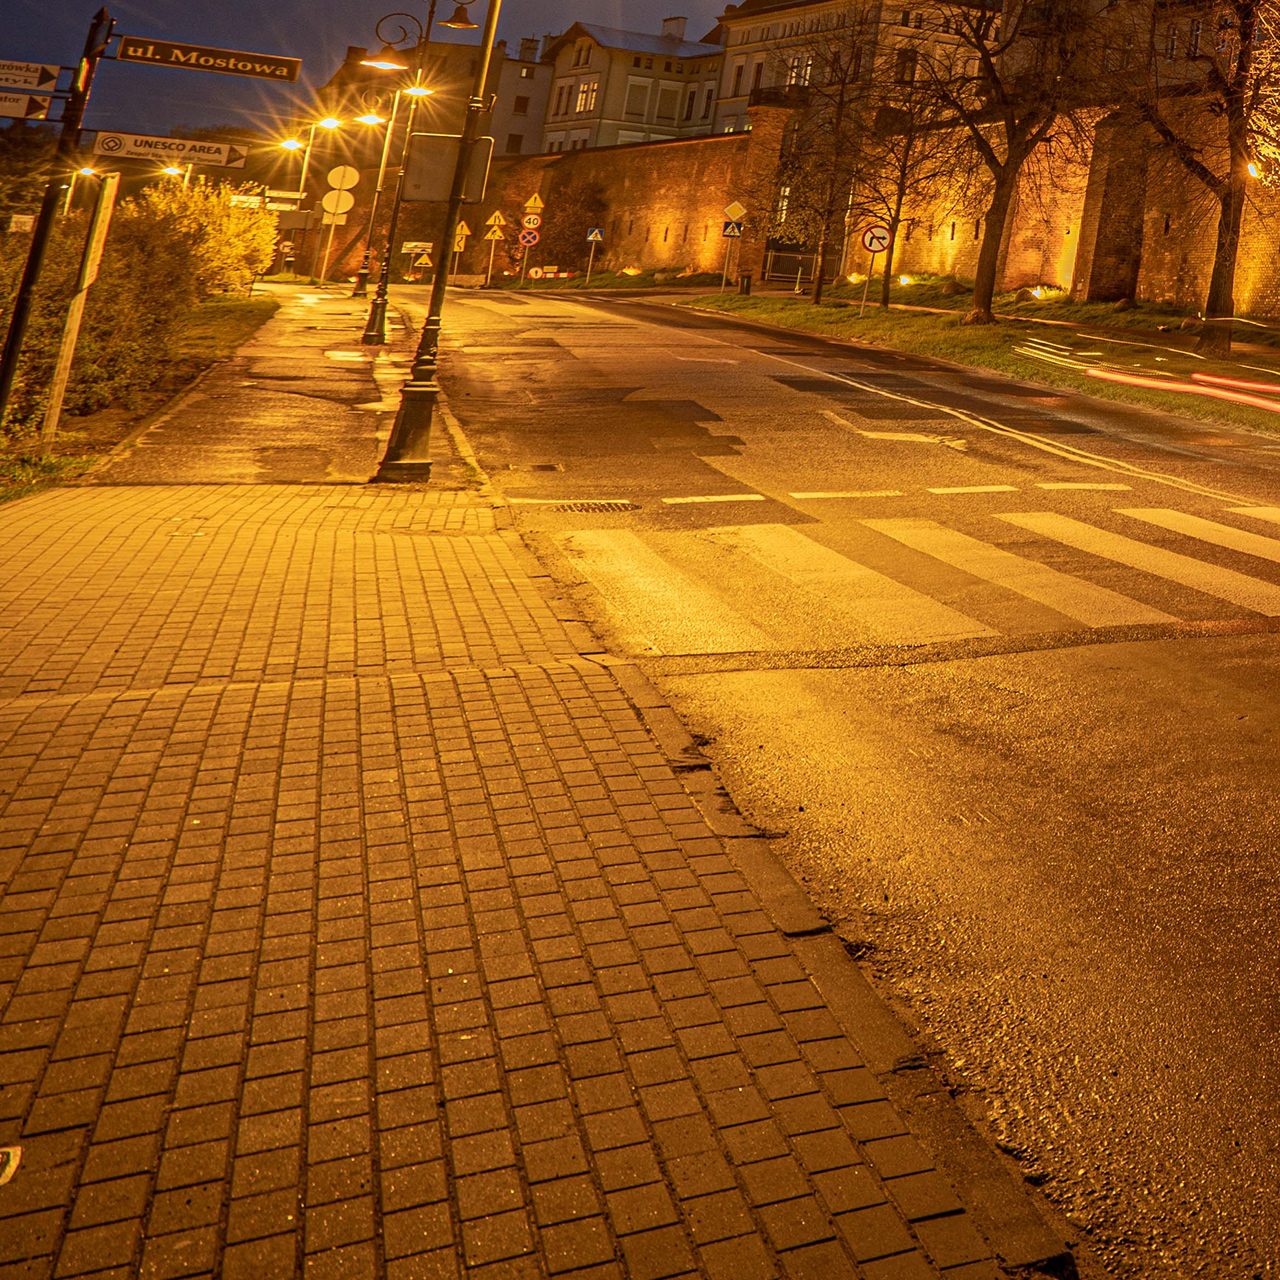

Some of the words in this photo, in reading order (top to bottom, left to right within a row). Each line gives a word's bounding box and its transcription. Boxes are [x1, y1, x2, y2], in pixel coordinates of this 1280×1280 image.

[127, 45, 161, 59] ul.
[168, 48, 289, 77] Mostowa
[0, 63, 39, 74] rówka
[133, 138, 187, 153] UNESCO
[188, 144, 223, 156] AREA
[525, 217, 539, 226] 40
